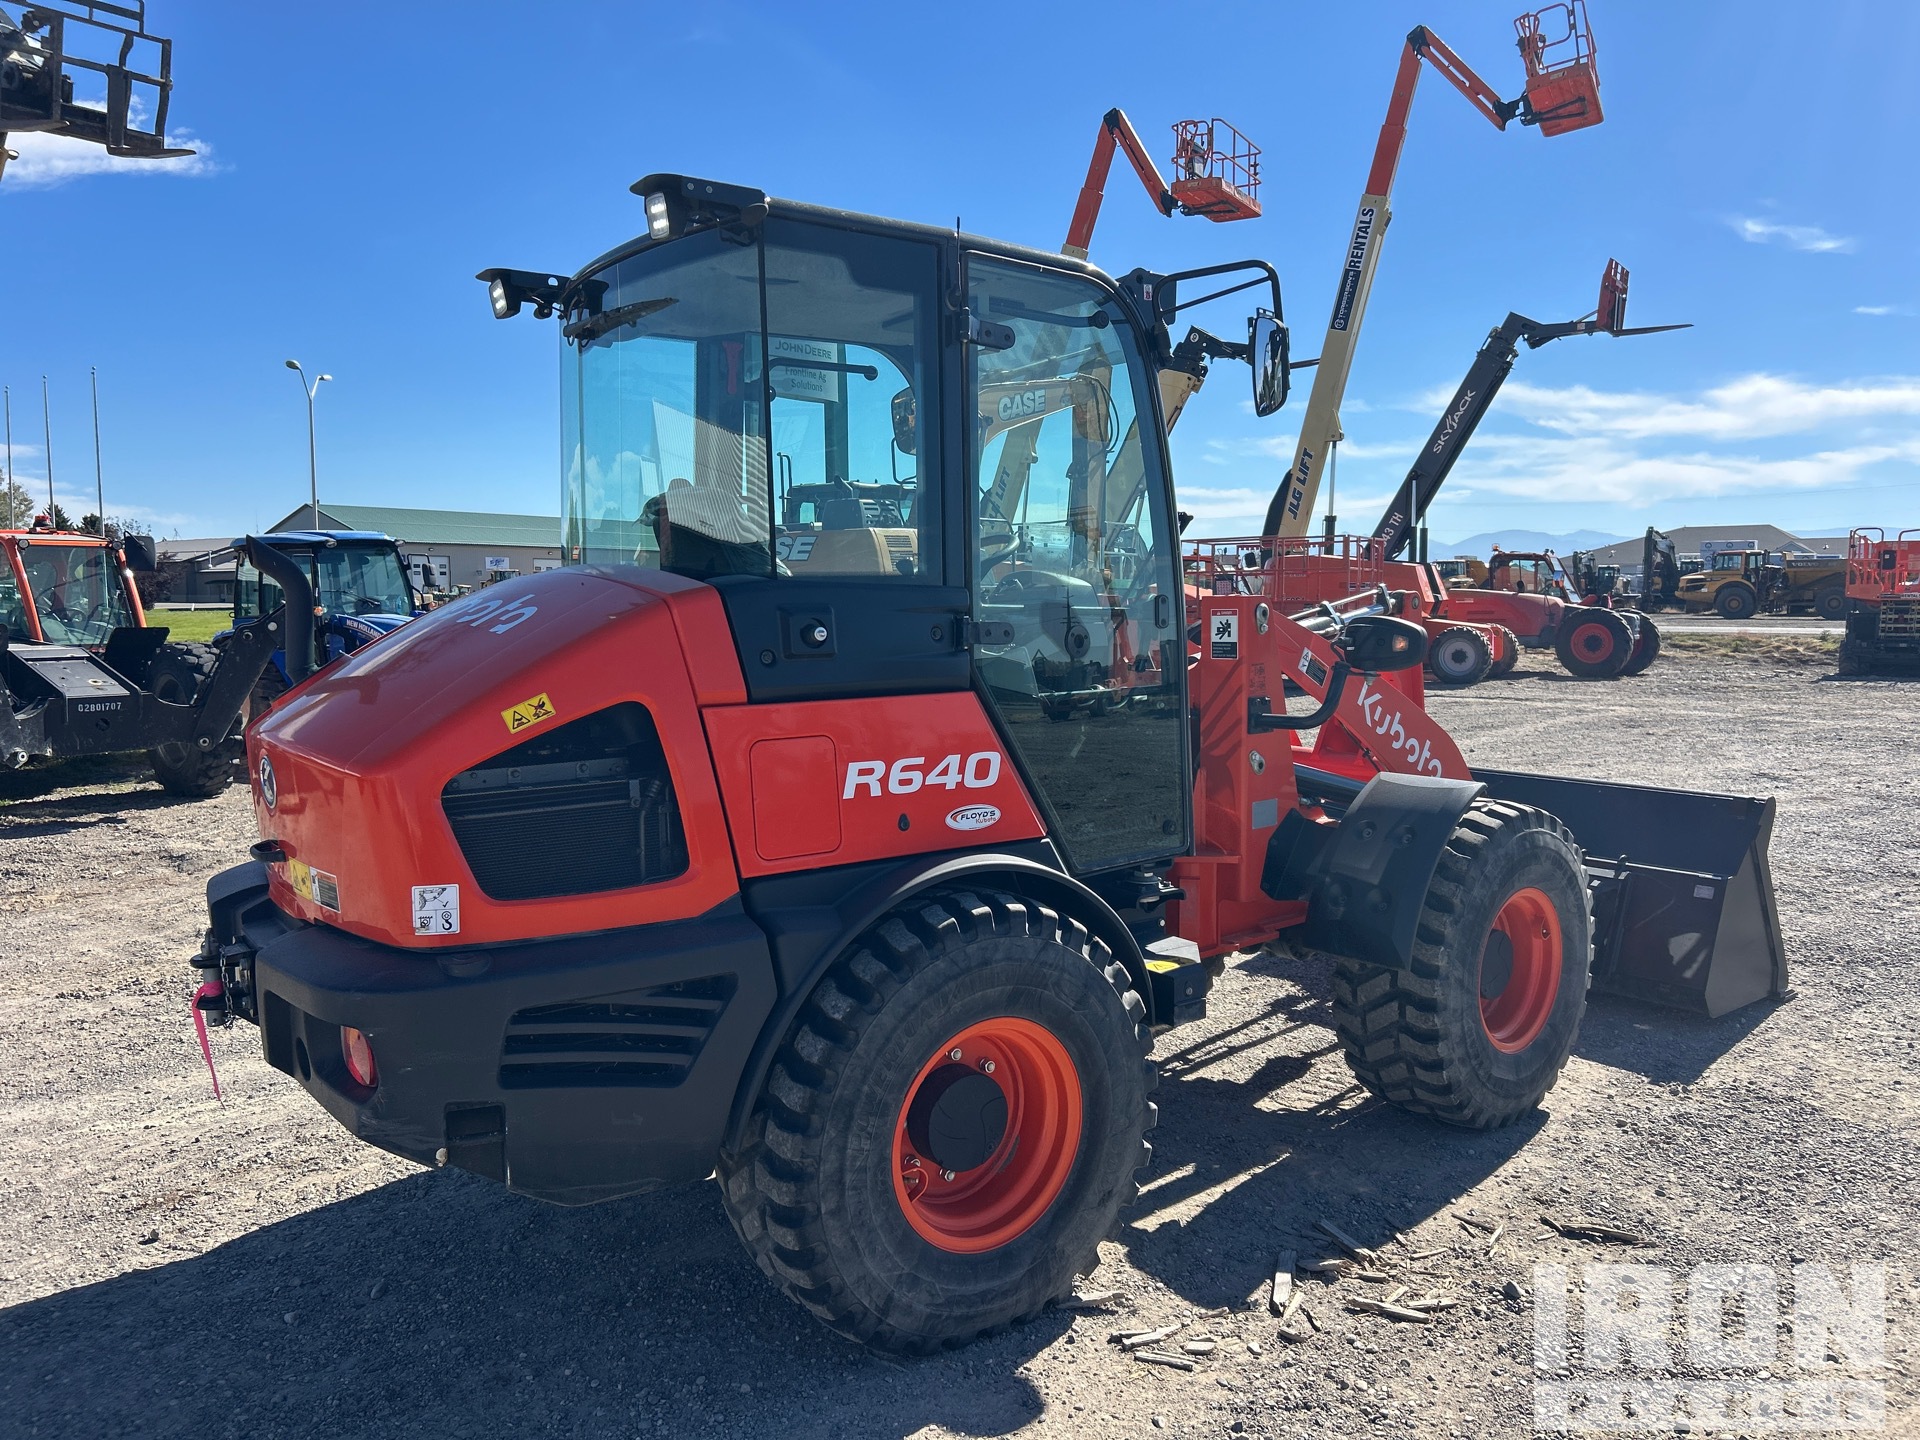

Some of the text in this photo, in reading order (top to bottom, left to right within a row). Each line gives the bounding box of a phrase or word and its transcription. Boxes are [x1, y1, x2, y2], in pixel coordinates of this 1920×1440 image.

[1347, 206, 1375, 270] RENTALS
[775, 340, 832, 360] JOHN DEERE
[785, 366, 827, 384] Frontline Ag
[791, 379, 823, 392] Solutions
[998, 388, 1046, 421] CASE
[1433, 389, 1476, 454] SKYJACK
[995, 465, 1011, 501] LIFT
[1287, 446, 1314, 521] JLG LIFT
[1388, 512, 1404, 526] TH
[346, 618, 358, 629] NEW
[842, 751, 1002, 800] R640
[960, 810, 996, 821] FLOYD'S
[975, 816, 997, 824] Kubota
